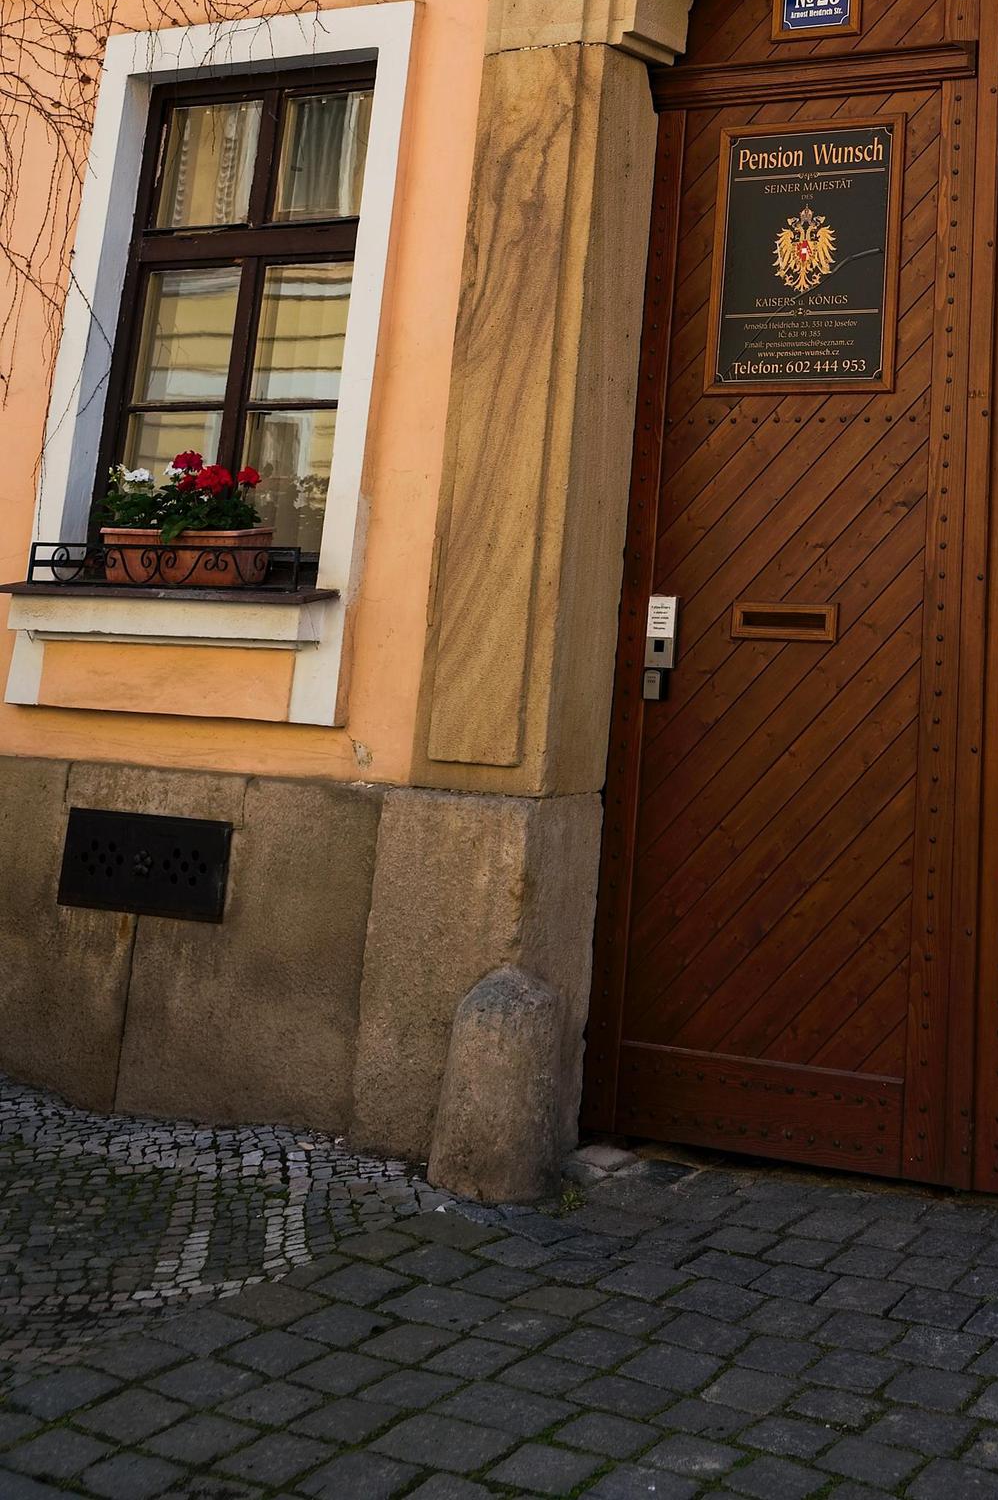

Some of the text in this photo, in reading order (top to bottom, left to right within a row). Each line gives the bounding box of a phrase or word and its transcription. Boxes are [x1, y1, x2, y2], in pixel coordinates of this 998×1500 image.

[738, 137, 883, 171] Pension Wunsch
[764, 178, 852, 194] SEINER MAJESTÄT
[755, 297, 796, 308] KAISERS
[808, 294, 848, 305] KÖNIGS
[757, 348, 839, 358] www.pension-wunsch.cz
[732, 359, 866, 375] Telefon: 602 444 953
